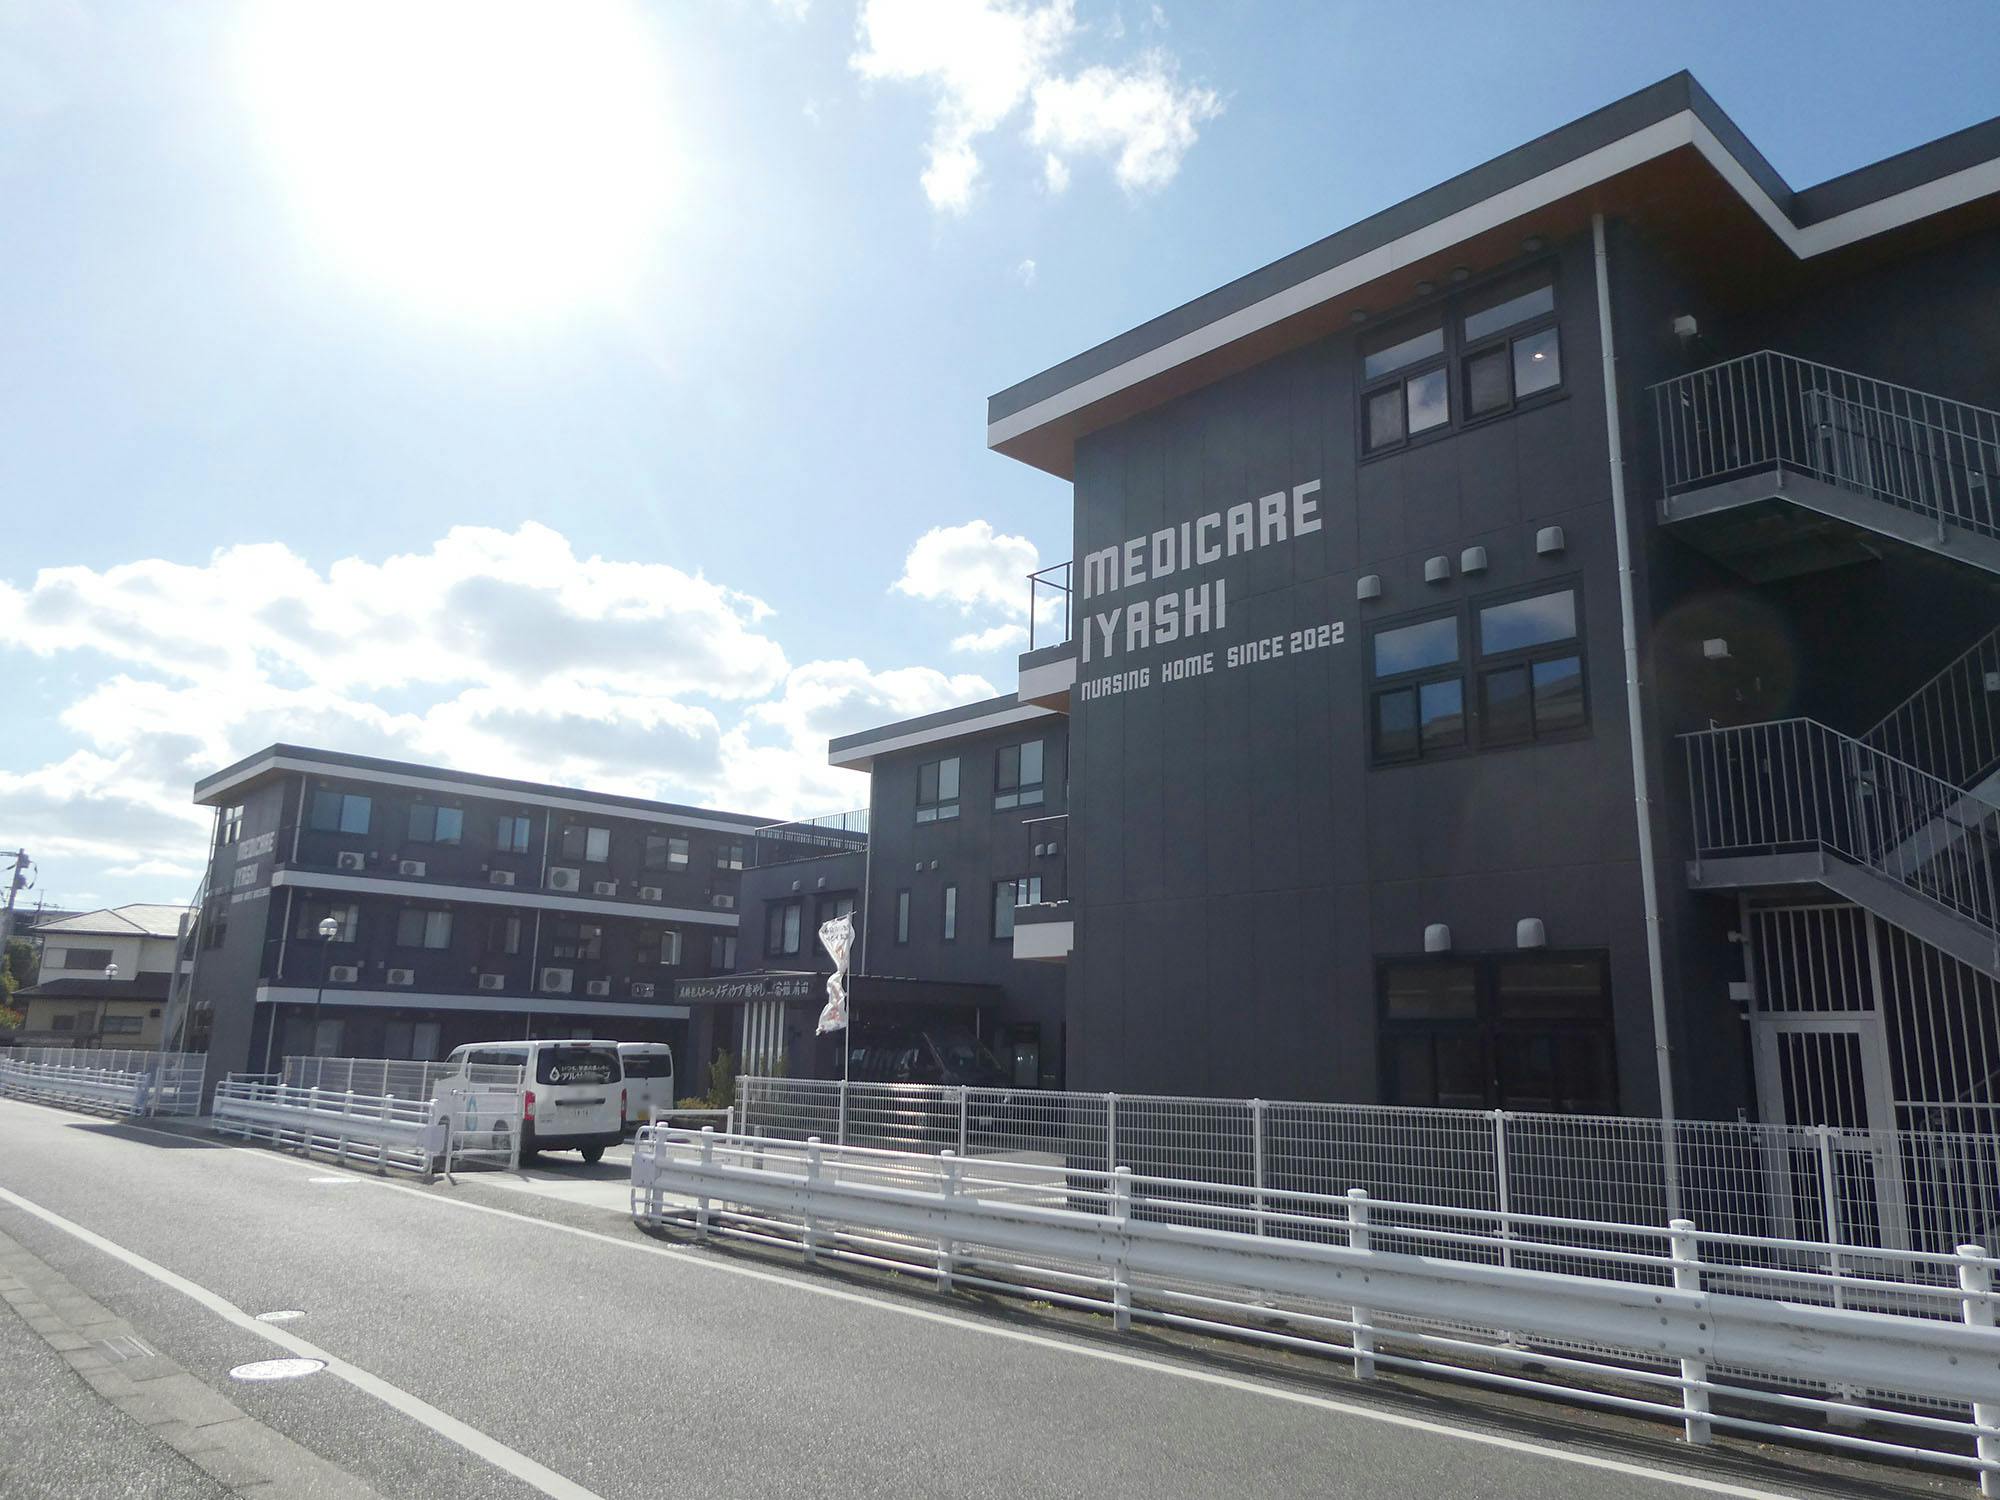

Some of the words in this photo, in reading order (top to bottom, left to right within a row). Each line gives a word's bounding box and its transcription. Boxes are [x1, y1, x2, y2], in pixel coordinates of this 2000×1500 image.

[1083, 479, 1322, 600] MEDICARE
[1081, 667, 1150, 701] NURSING
[1162, 652, 1214, 683] HOME
[1227, 636, 1284, 668] SINCE
[1290, 621, 1345, 654] 2022
[1082, 578, 1226, 664] IYASHI
